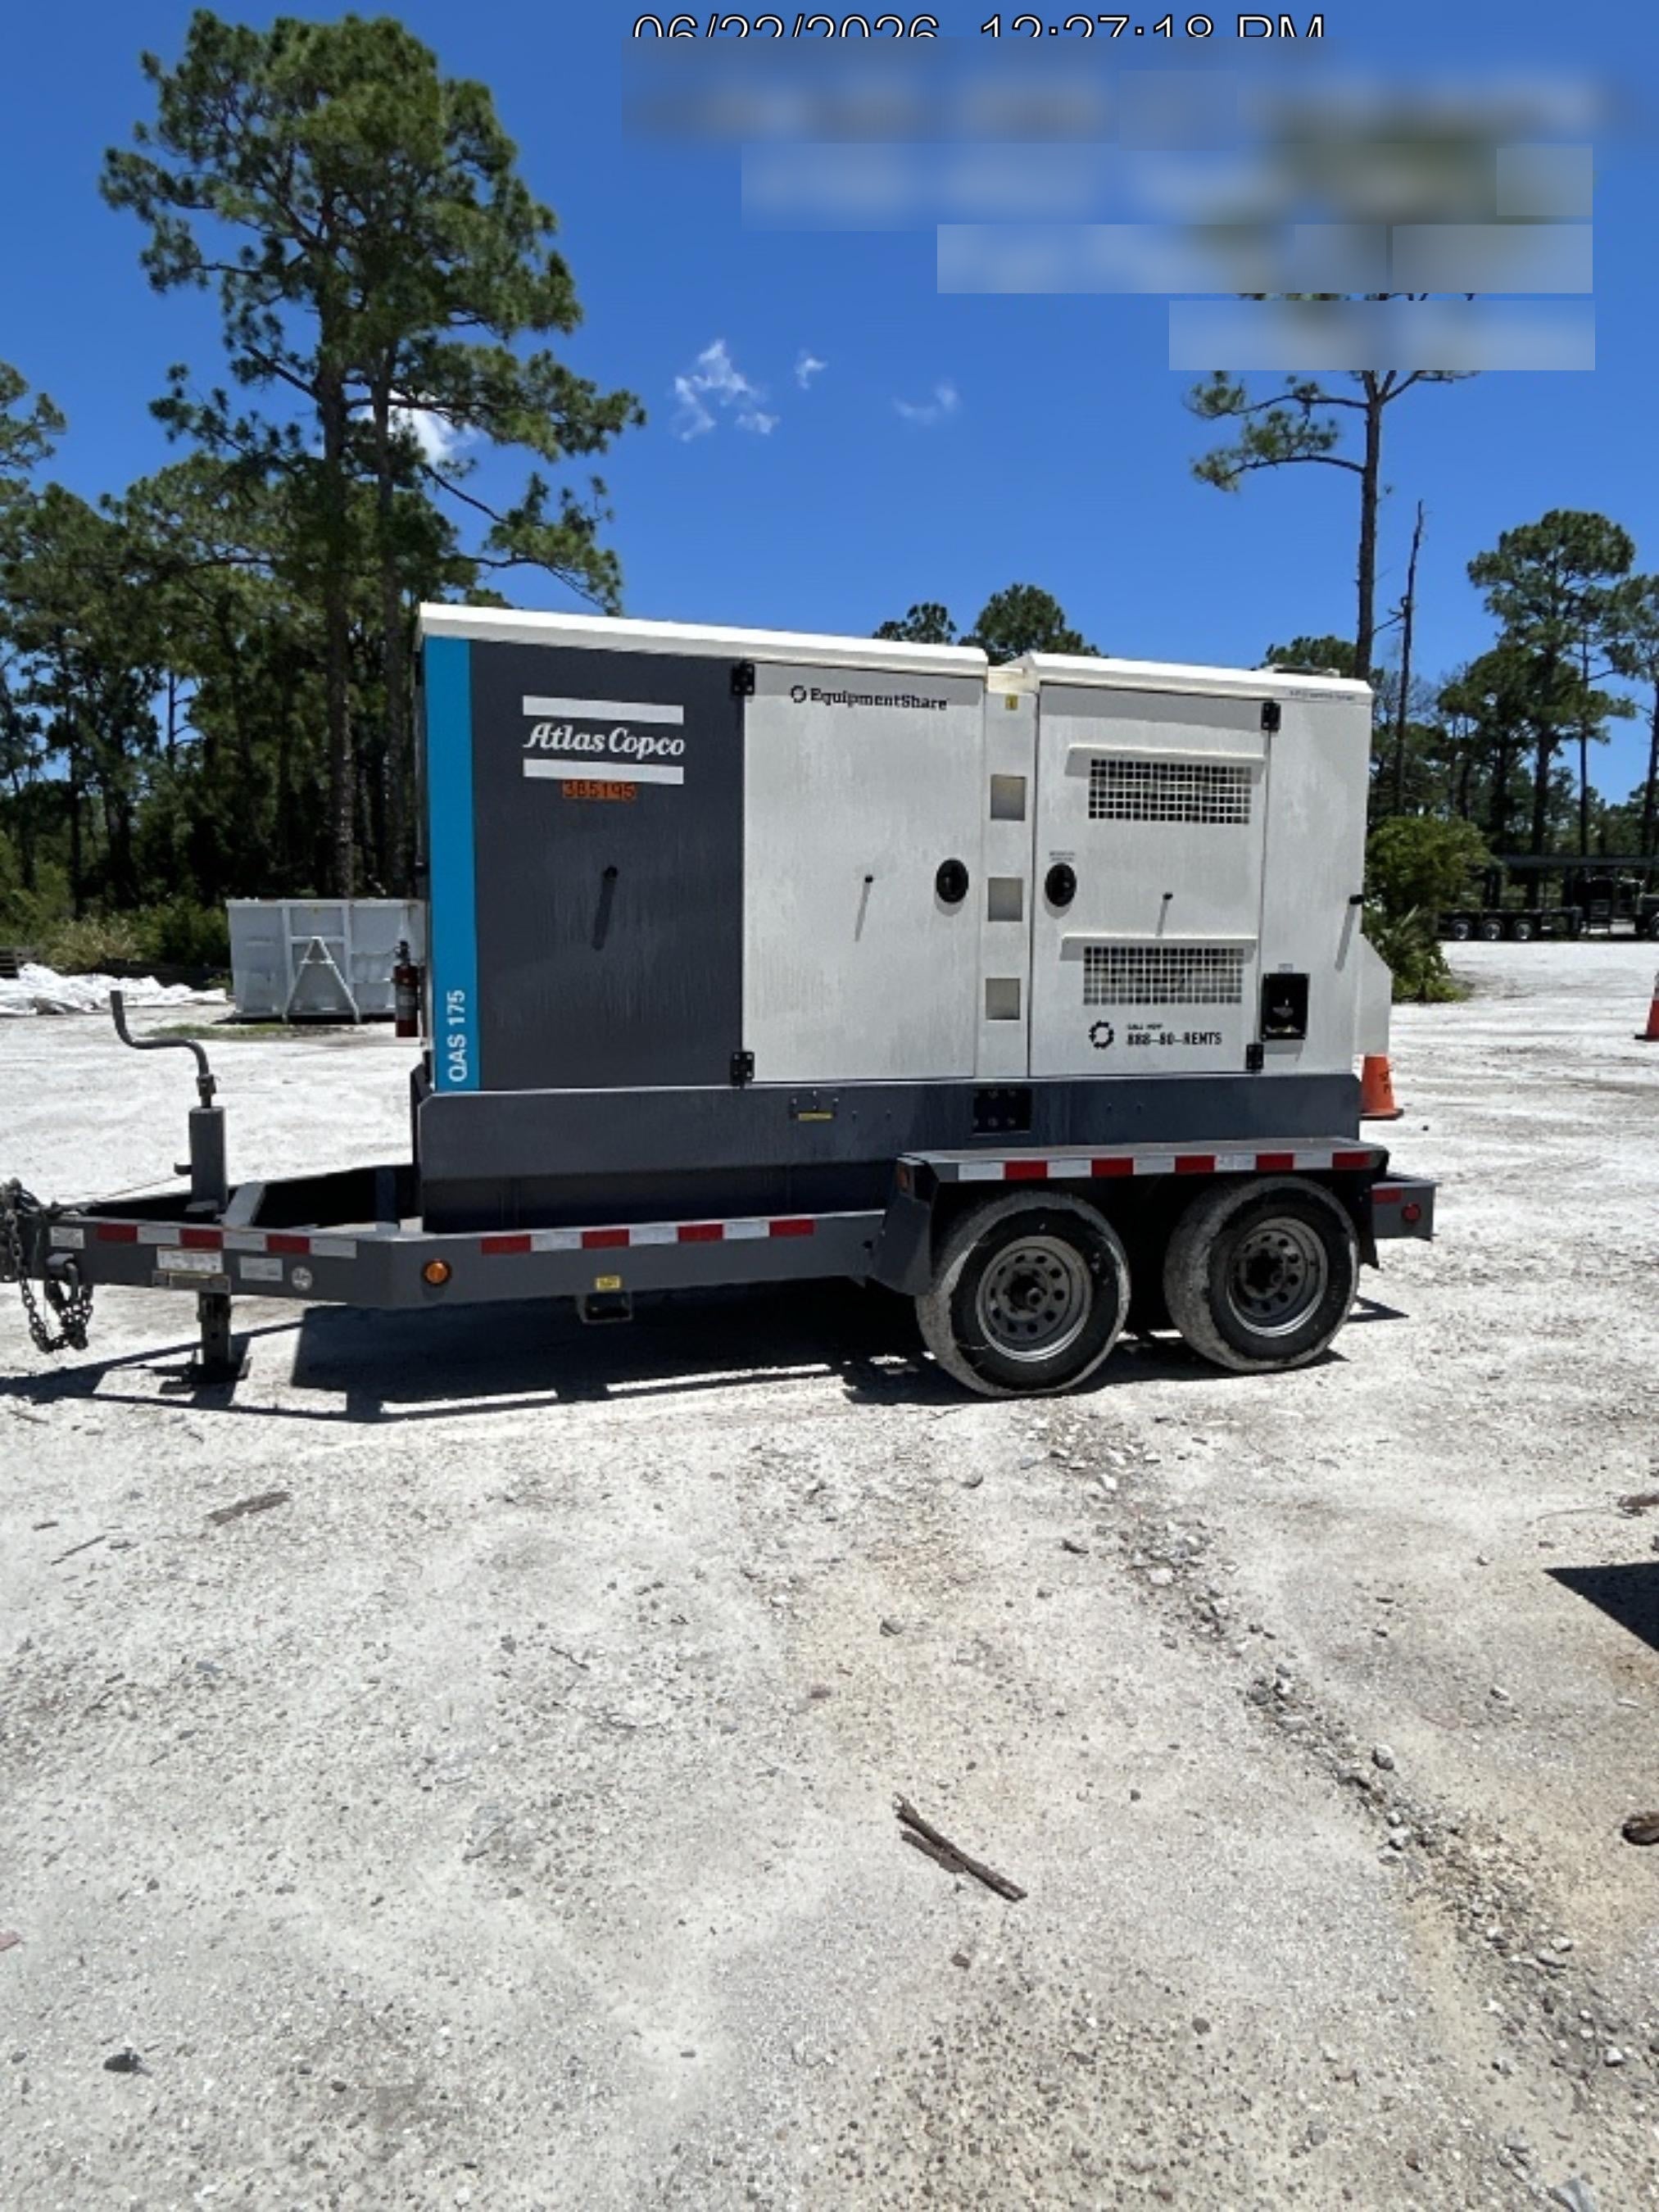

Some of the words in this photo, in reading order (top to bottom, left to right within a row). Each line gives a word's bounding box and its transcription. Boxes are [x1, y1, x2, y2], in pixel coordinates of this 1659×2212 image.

[810, 687, 947, 710] EquipmentShare
[523, 722, 605, 751] Atlas
[609, 727, 685, 760] Copco
[446, 989, 465, 1027] 175
[446, 1034, 467, 1082] QAS
